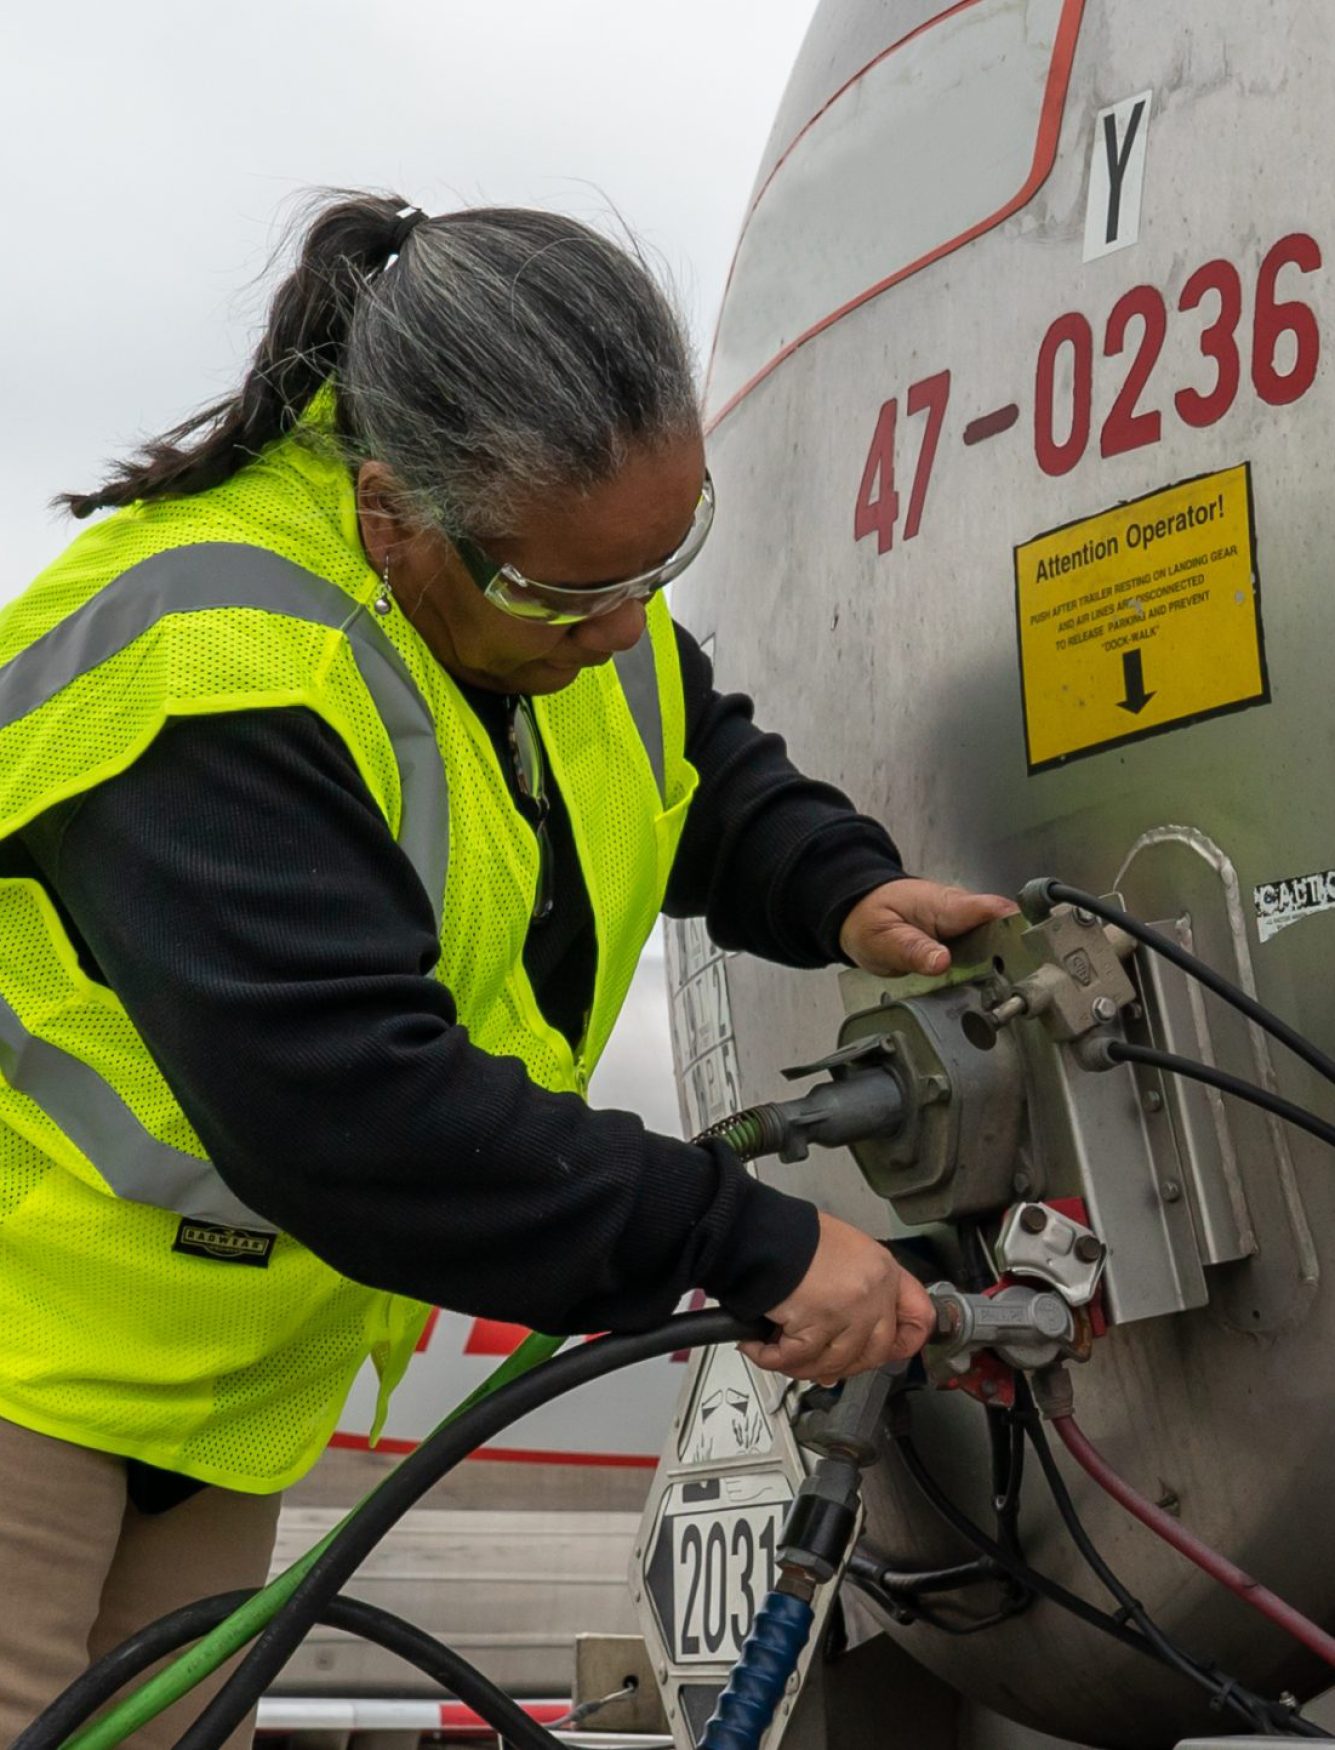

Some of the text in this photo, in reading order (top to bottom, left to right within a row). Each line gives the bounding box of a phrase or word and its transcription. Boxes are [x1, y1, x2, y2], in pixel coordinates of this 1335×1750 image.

[1103, 99, 1146, 245] Y
[854, 233, 1321, 555] 47-0236
[1036, 494, 1224, 583] Attention Operator!
[1030, 545, 1238, 626] PUSH AFTER TRAILER RESTING ON LANDING GEAR
[1056, 590, 1210, 650] TO RELEASE PARKING AND PREVENT
[1058, 620, 1076, 633] AND
[1076, 612, 1089, 626] AIR
[1090, 604, 1114, 622] LINES
[1136, 574, 1205, 603] DISCONNECTED
[680, 1515, 776, 1655] 2031
